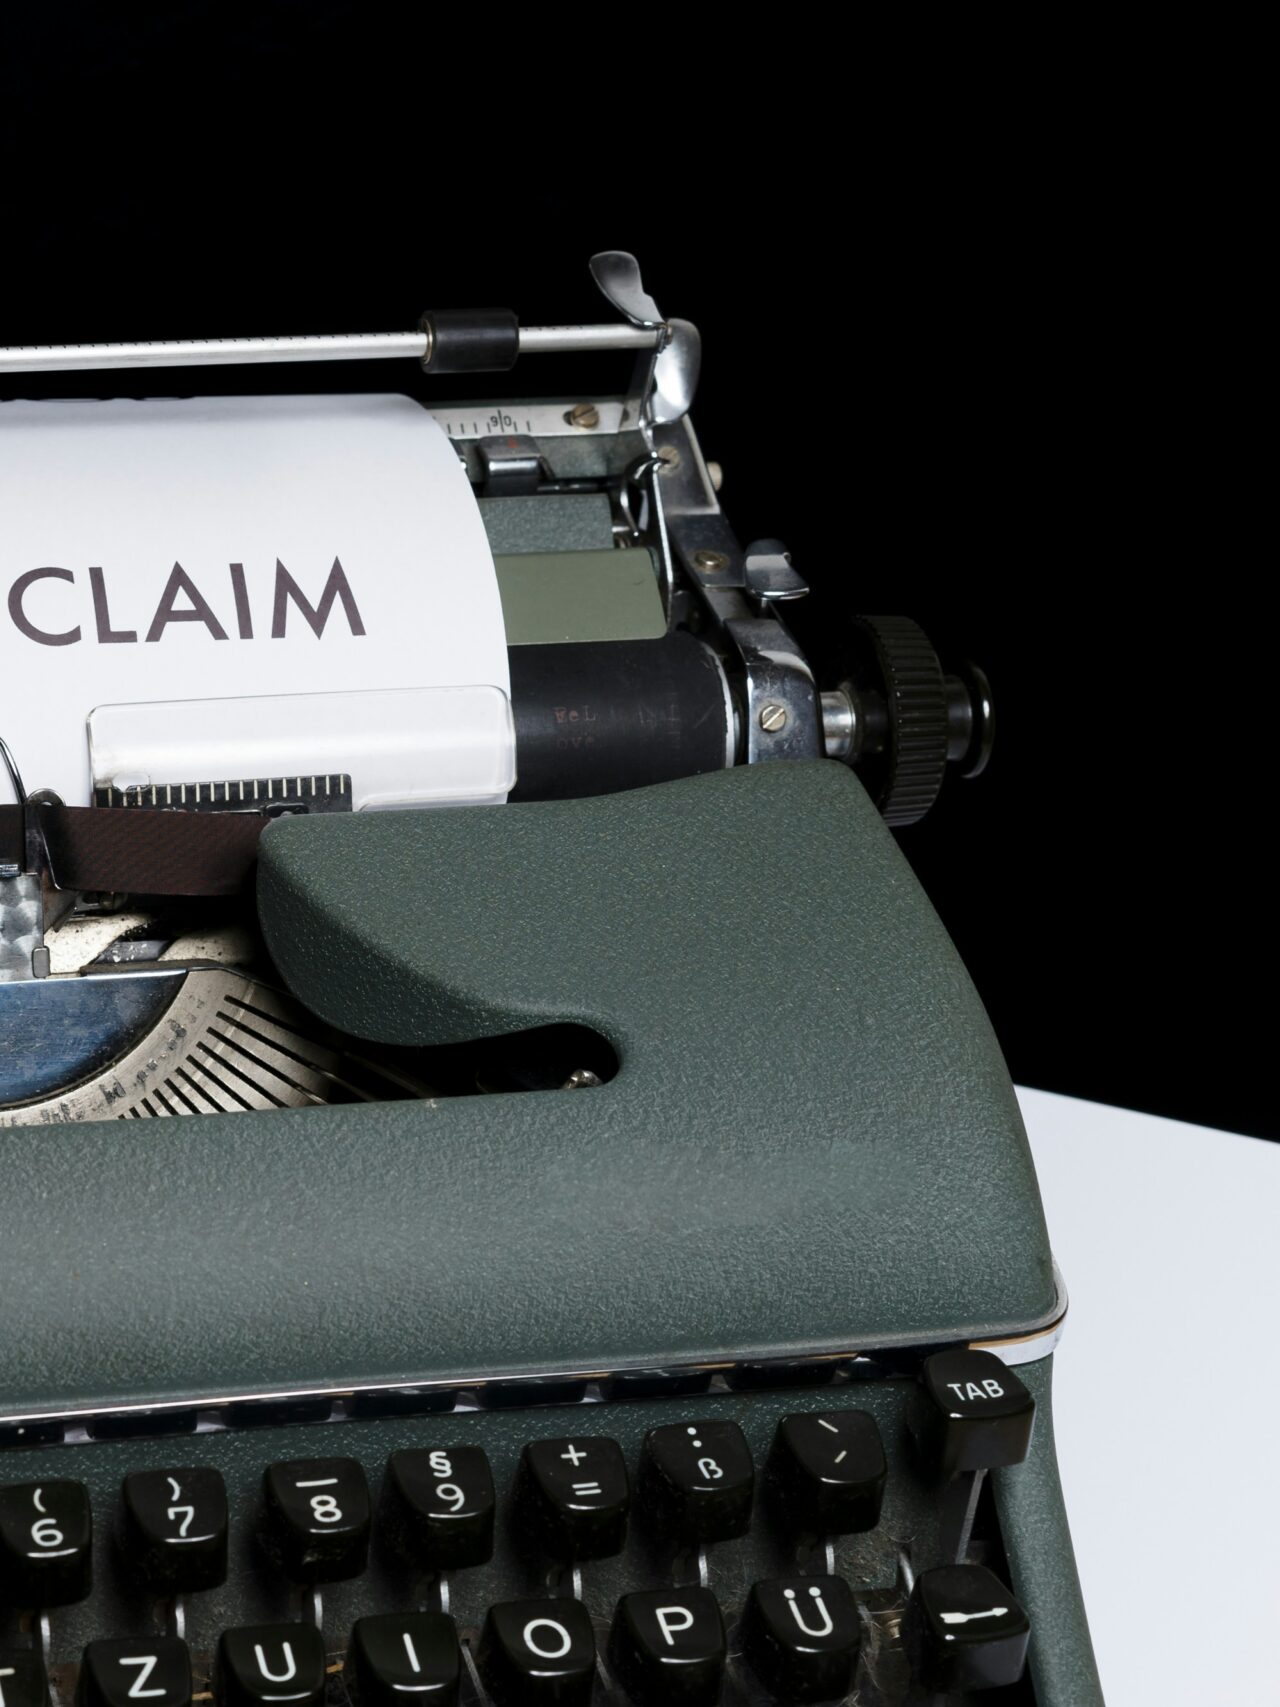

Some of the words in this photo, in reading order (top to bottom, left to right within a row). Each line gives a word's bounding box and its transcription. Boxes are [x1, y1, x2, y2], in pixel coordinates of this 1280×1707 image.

[8, 556, 366, 646] CLAIM
[947, 1380, 1004, 1400] TAB
[430, 1451, 452, 1477] §
[561, 1445, 586, 1466] +
[436, 1484, 464, 1511] 9
[573, 1482, 601, 1495] =
[168, 1506, 194, 1536] 7
[310, 1495, 342, 1522] 8
[31, 1519, 63, 1546] 6
[784, 1587, 833, 1636] Ü
[524, 1619, 571, 1658] O
[656, 1607, 693, 1645] P
[255, 1642, 296, 1681] U
[120, 1656, 166, 1697] Z
